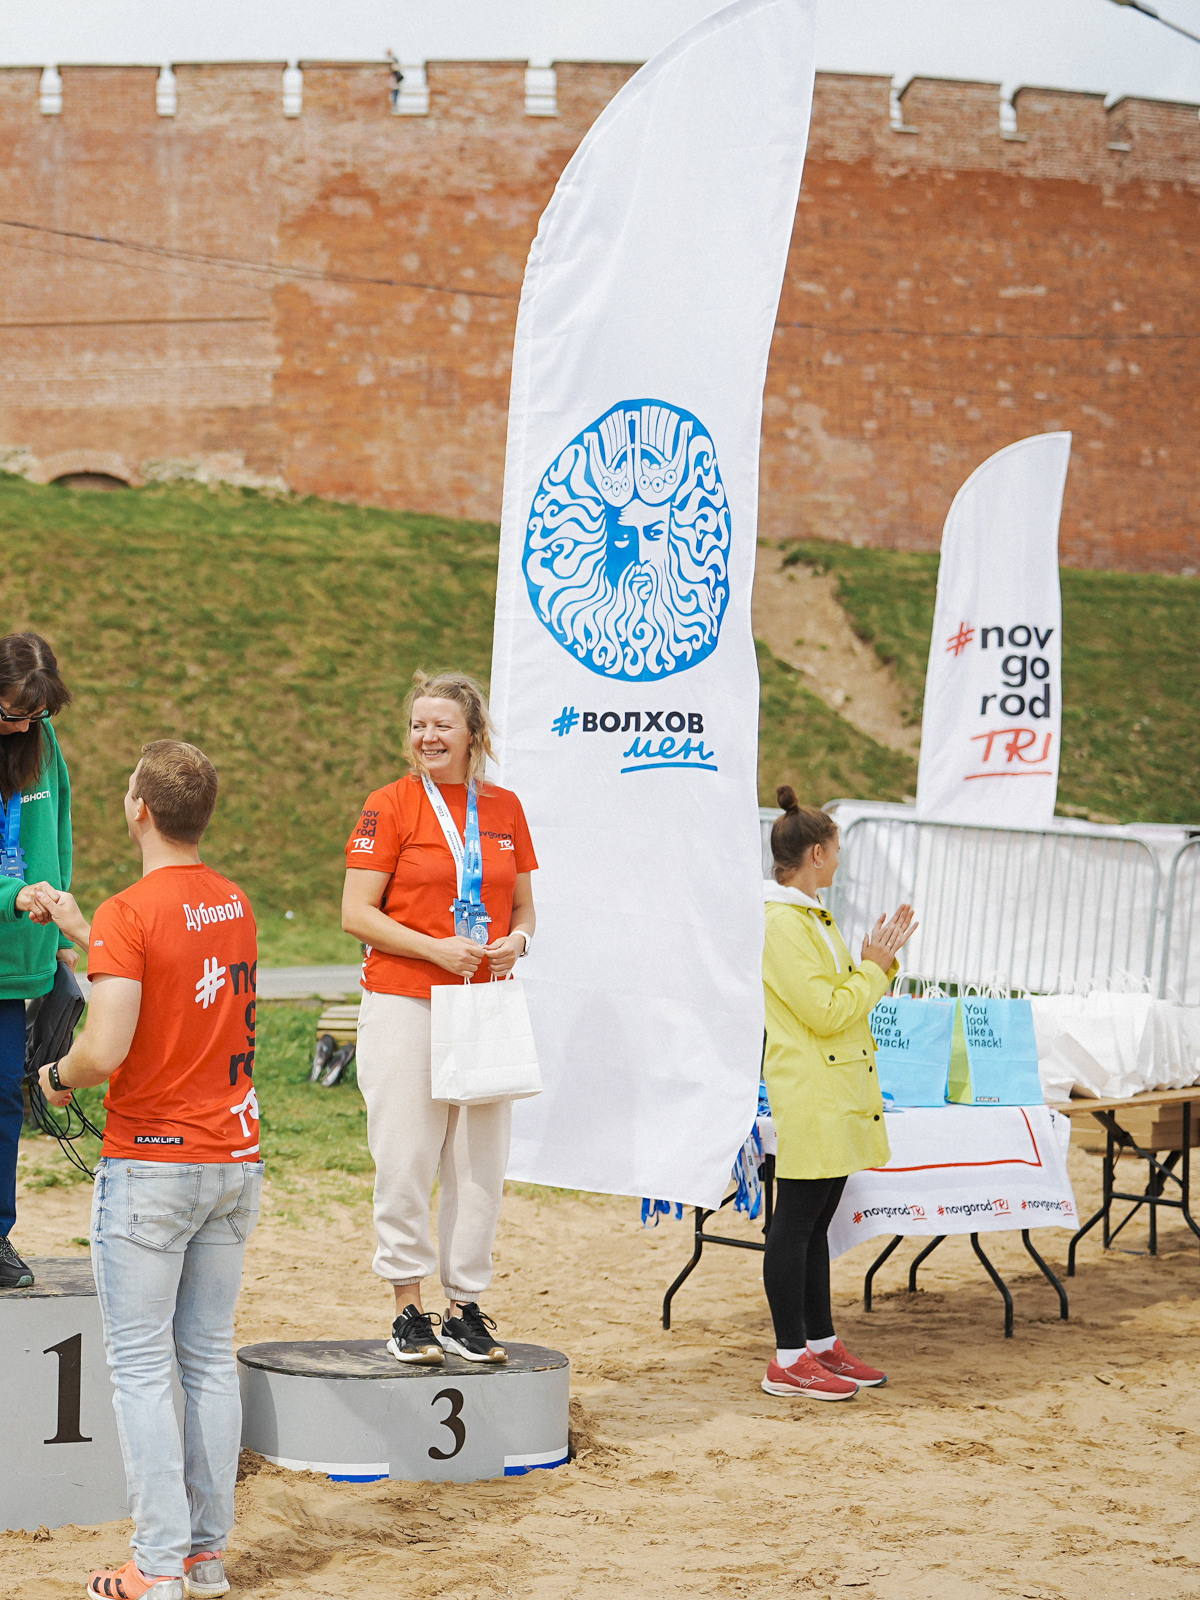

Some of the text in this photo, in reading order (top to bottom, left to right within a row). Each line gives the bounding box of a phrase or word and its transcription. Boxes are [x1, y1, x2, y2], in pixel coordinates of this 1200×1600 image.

[946, 622, 1054, 656] #nov
[1002, 655, 1050, 688] go
[980, 683, 1050, 718] rod
[551, 706, 704, 737] #ВОЛХОВ
[623, 737, 714, 760] мен
[971, 728, 1052, 763] TRI
[363, 818, 377, 828] go
[357, 826, 376, 837] rod
[353, 837, 375, 850] TRI
[183, 894, 244, 932] Дубовой
[875, 1003, 897, 1015] You
[964, 1004, 987, 1015] You
[871, 1013, 898, 1026] look
[966, 1015, 989, 1026] look
[870, 1024, 902, 1037] like a
[967, 1026, 994, 1037] like a
[875, 1038, 910, 1049] nack!
[968, 1037, 1002, 1048] snack!
[43, 1332, 92, 1445] 1
[427, 1387, 467, 1461] 3
